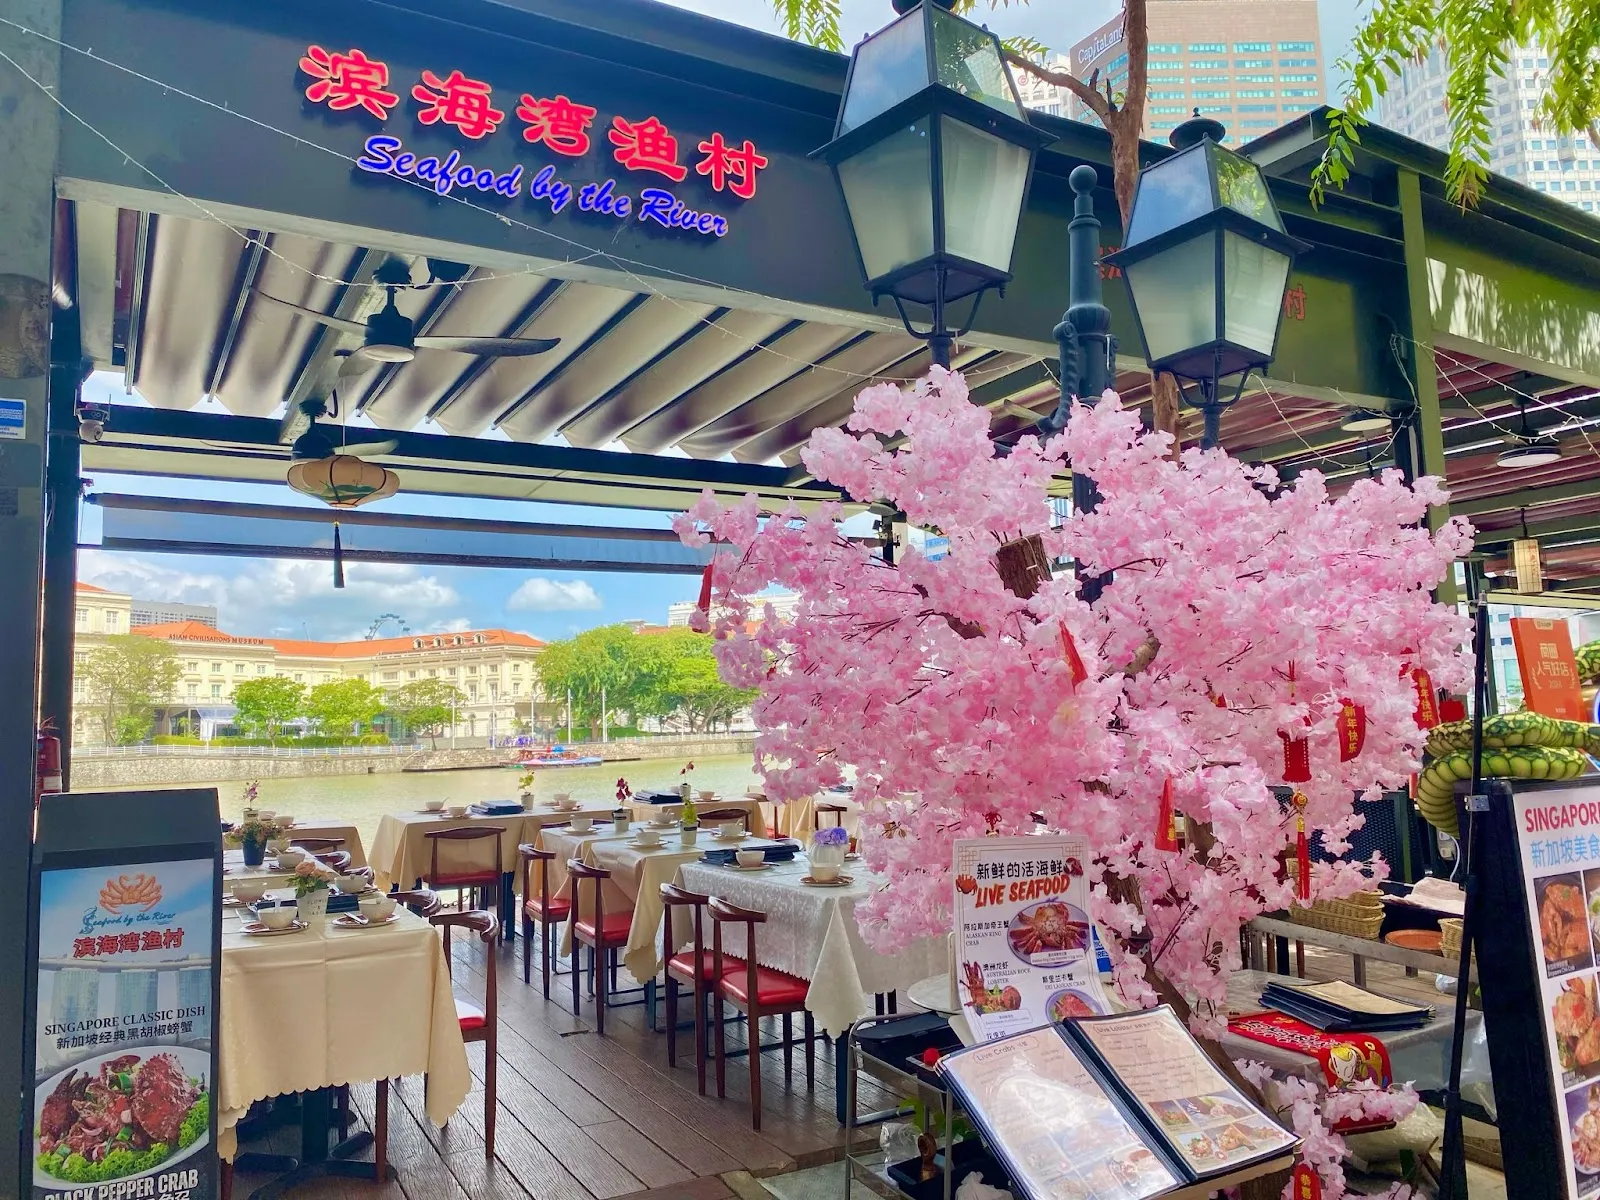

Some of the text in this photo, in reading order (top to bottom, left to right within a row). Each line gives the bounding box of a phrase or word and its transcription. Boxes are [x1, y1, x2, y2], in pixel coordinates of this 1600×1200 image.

[1078, 21, 1125, 64] CapitaLand
[298, 44, 768, 199] 滨海湾渔村
[356, 134, 729, 237] Seafood by the River
[168, 633, 264, 645] ASIAN CIVILISATIONS MUSEUM
[1343, 705, 1358, 753] 新年快乐
[1530, 833, 1600, 869] 新加坡美食
[976, 859, 1063, 880] 新鲜的活海鲜
[975, 874, 1071, 909] LIVE SEAFOOD
[122, 914, 133, 926] by
[136, 912, 150, 921] the
[73, 927, 185, 958] 滨海湾渔村
[44, 1005, 206, 1036] SINGAPORE CLASSIC DISH
[56, 1020, 193, 1050] 新加坡经典黑胡椒螃蟹
[976, 1045, 1016, 1061] Live Crabs
[98, 1176, 155, 1200] PEPPER
[157, 1169, 199, 1194] CRAB
